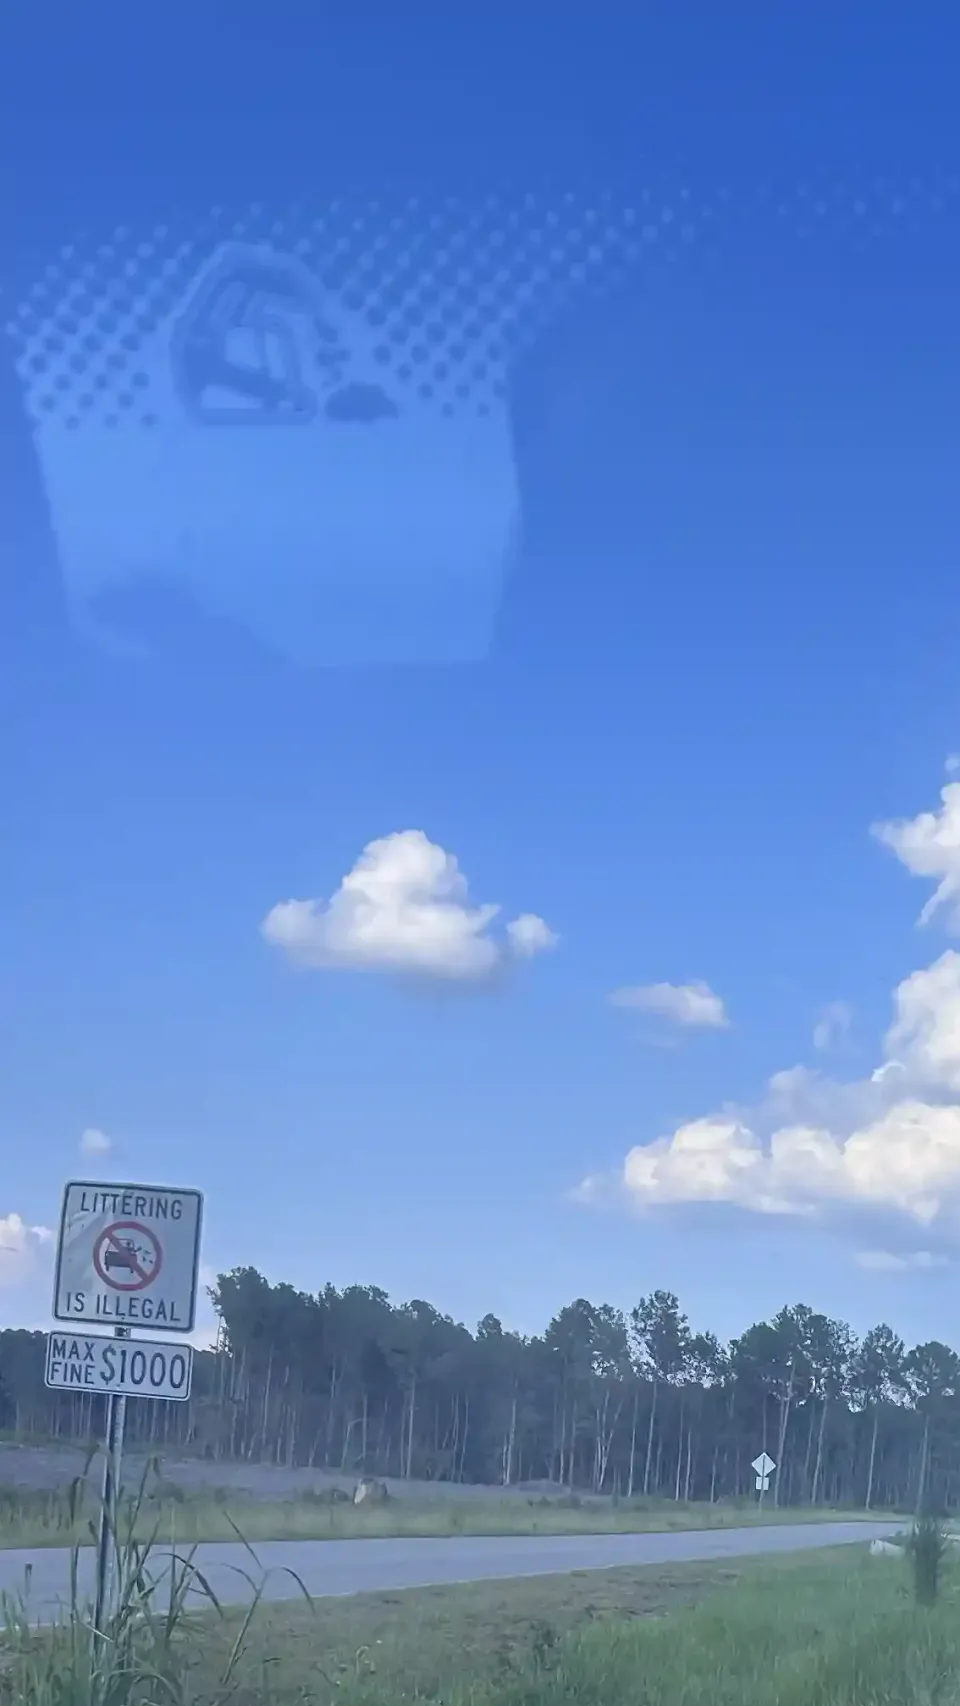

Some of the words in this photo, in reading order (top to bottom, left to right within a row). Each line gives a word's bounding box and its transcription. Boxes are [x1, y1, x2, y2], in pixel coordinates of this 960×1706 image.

[80, 1191, 183, 1220] LITTERING
[66, 1291, 85, 1312] IS
[96, 1294, 181, 1322] ILLEGAL
[52, 1338, 95, 1362] MAX
[50, 1361, 95, 1385] FINE
[100, 1343, 186, 1389] $1000
